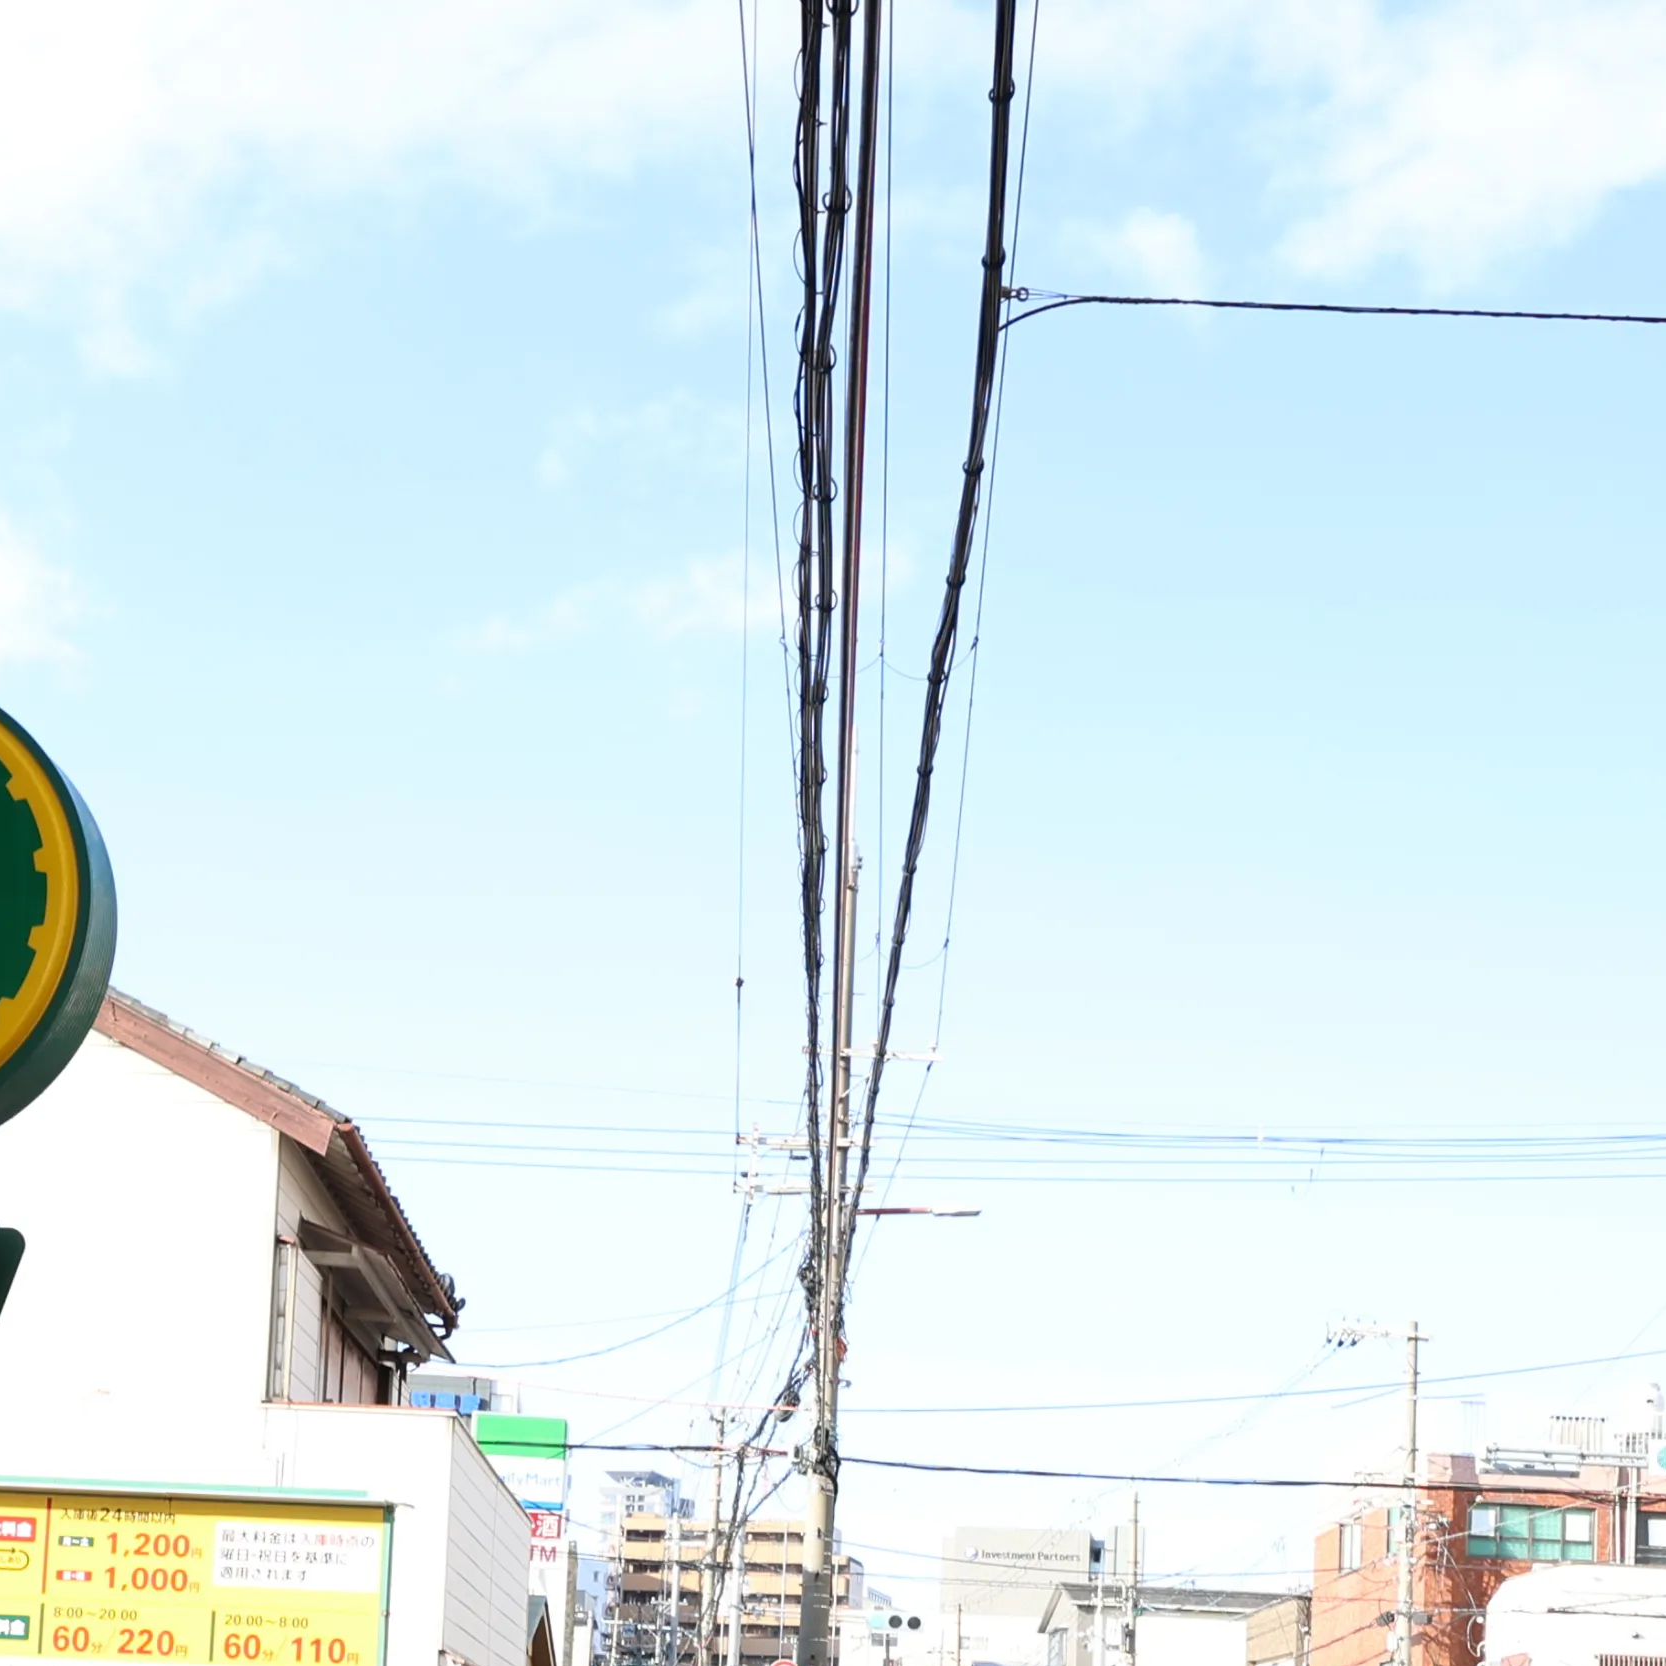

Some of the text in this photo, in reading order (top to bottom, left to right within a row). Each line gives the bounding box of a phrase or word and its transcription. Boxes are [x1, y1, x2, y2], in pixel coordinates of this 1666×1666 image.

[529, 1544, 557, 1563] TM
[981, 1549, 1081, 1562] Investment Partners
